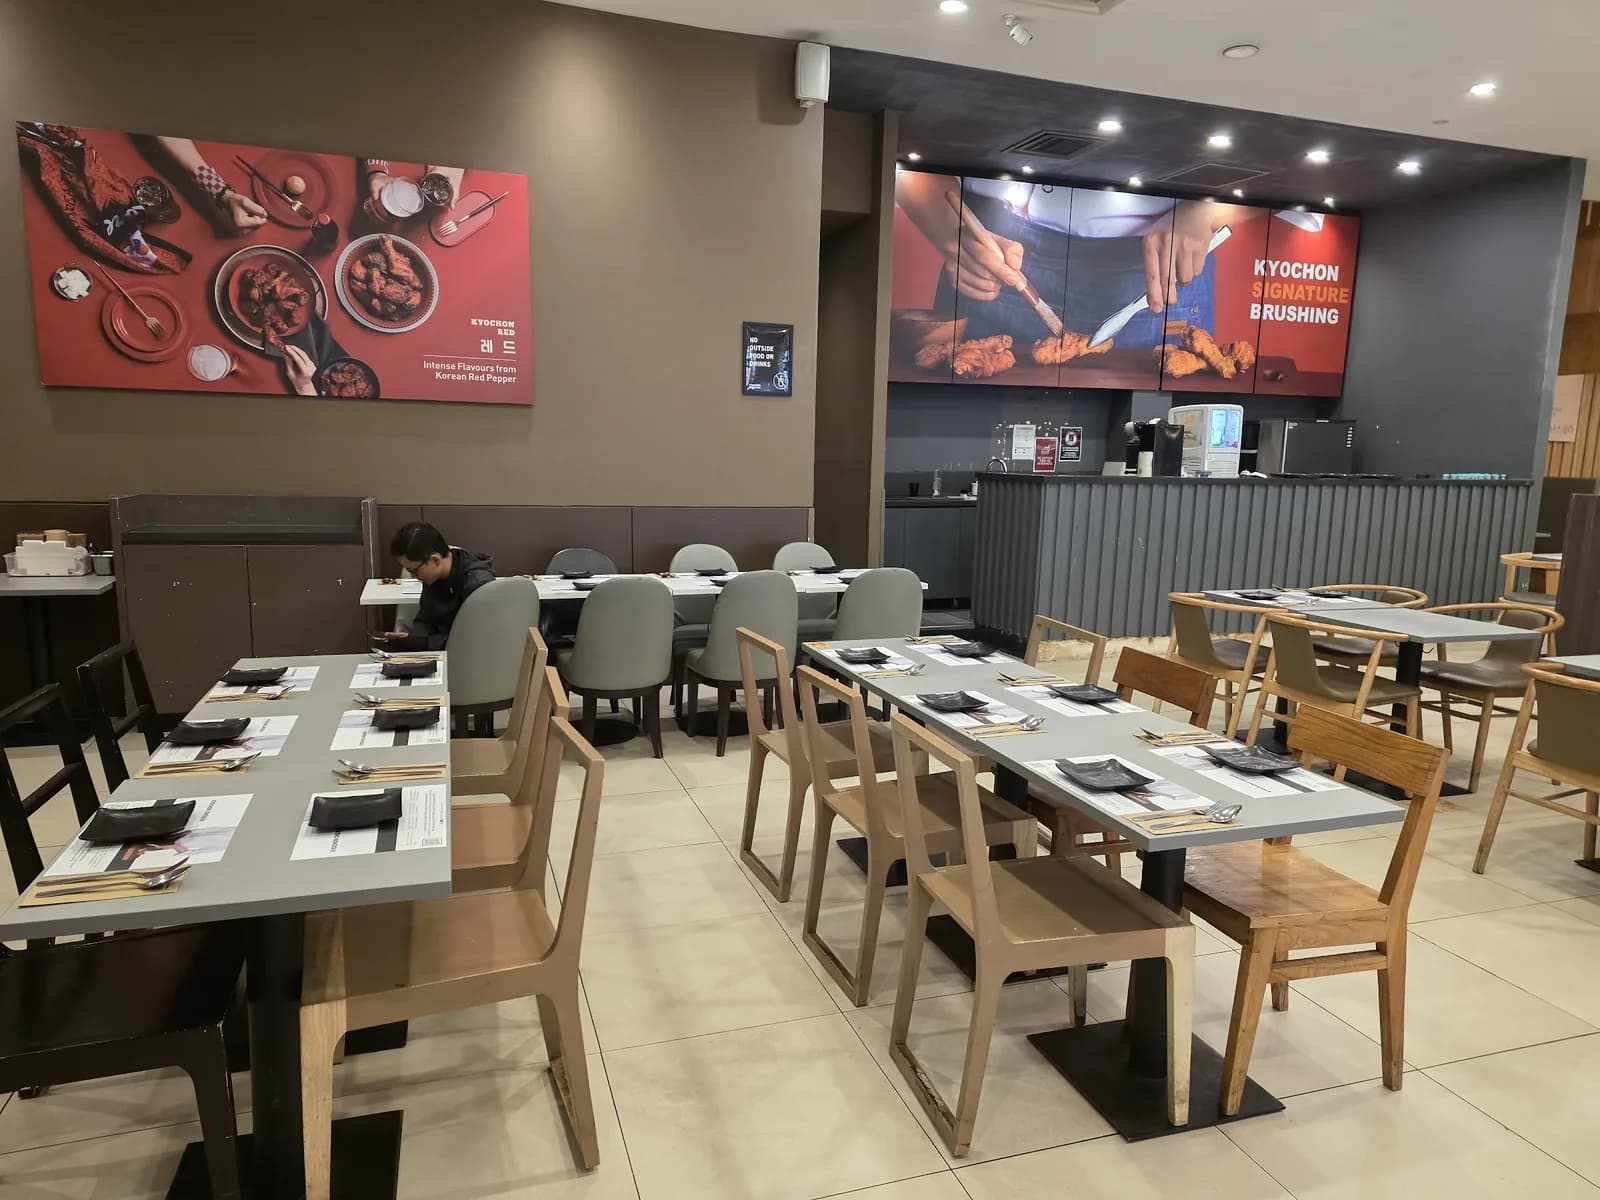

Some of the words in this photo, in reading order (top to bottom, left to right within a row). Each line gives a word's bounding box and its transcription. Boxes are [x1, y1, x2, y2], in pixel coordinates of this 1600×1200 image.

[1254, 259, 1339, 281] KYOCHON
[1252, 281, 1349, 303] SIGNATURE
[1250, 303, 1339, 324] BRUSHING
[471, 318, 515, 328] KYOCHON
[497, 328, 515, 336] RED
[423, 361, 456, 370] Intense
[457, 362, 495, 372] Flavours
[496, 365, 517, 373] from
[435, 371, 467, 381] Korean
[468, 373, 485, 382] Red
[486, 374, 517, 384] Pepper
